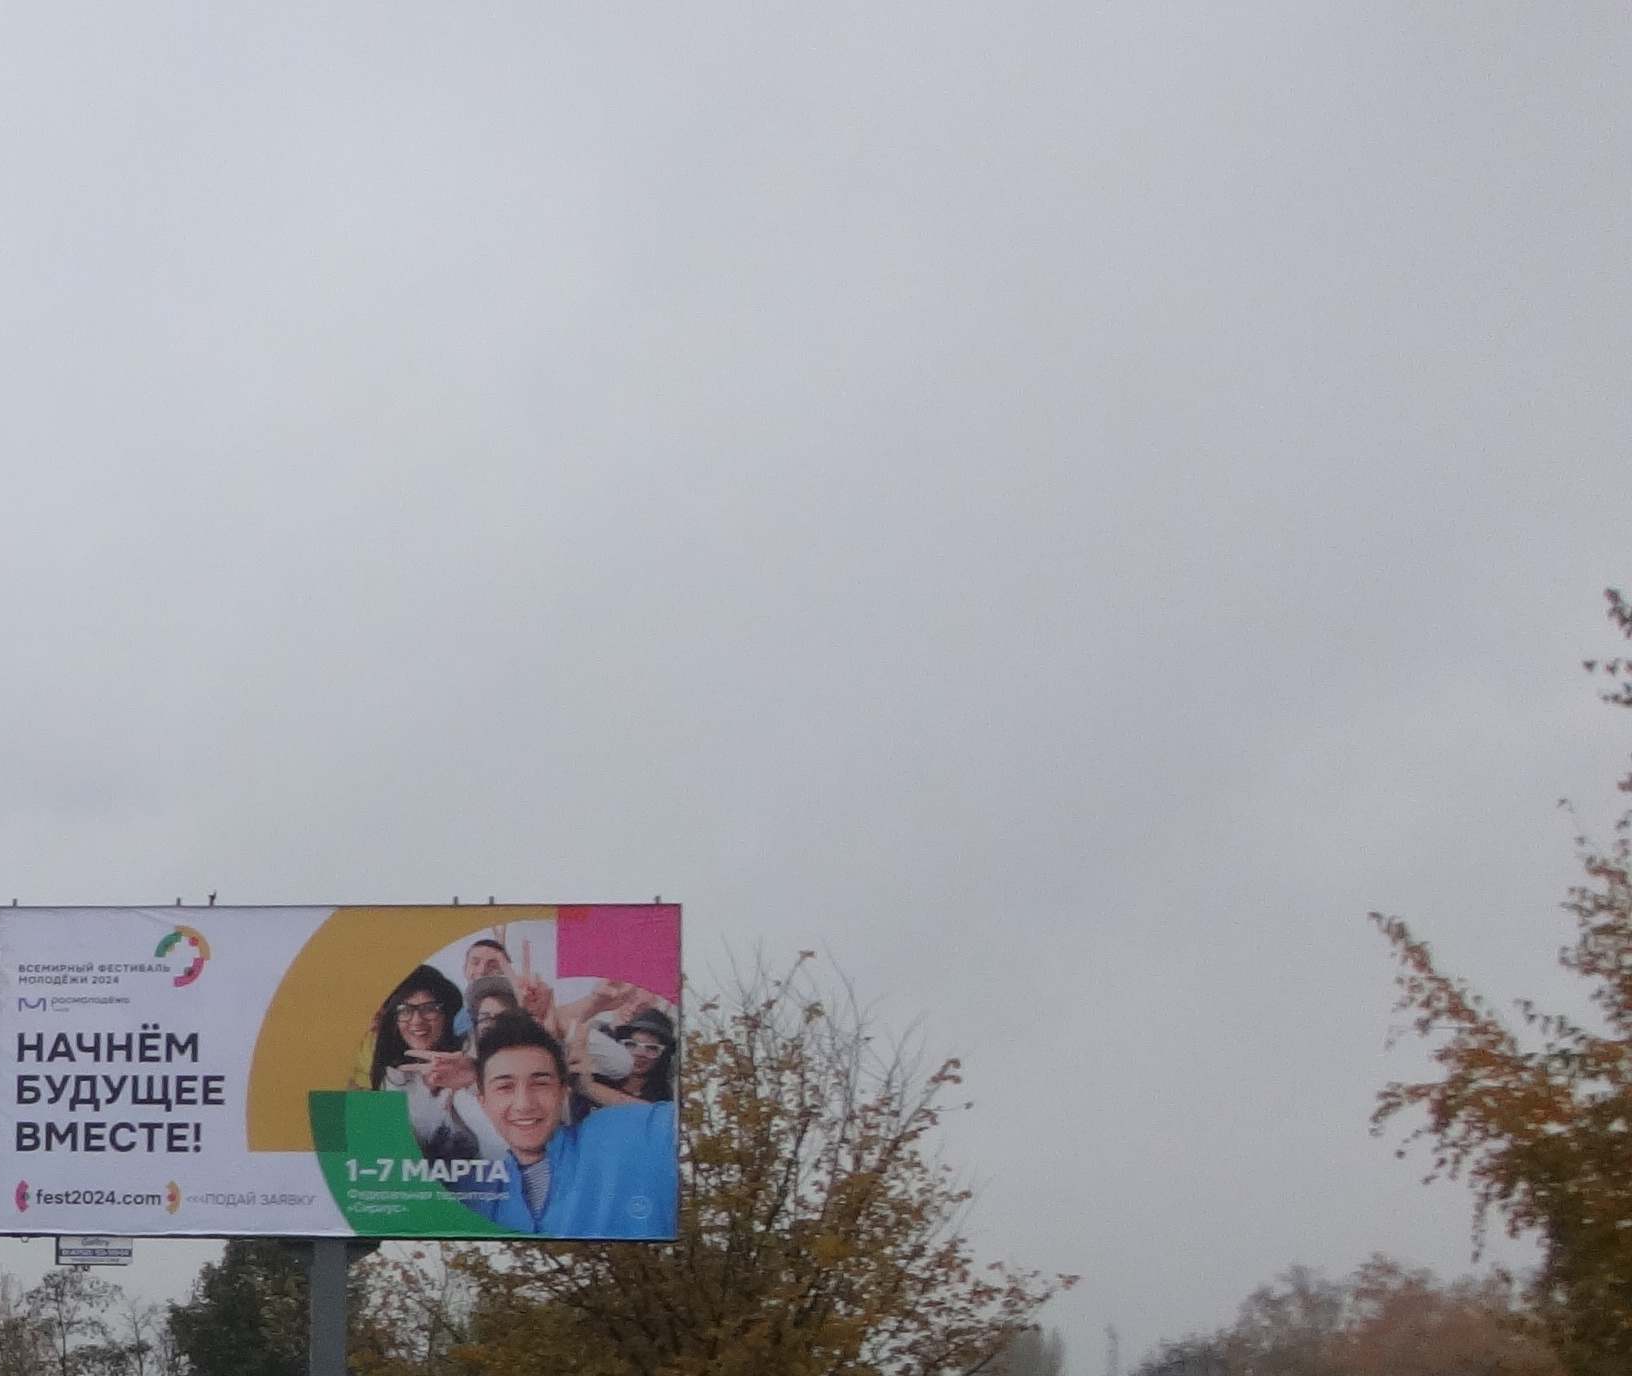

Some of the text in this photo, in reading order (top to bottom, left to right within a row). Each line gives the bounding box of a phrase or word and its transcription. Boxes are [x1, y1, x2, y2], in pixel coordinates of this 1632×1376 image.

[18, 962, 171, 973] ВСЕМИРНЫЙ ФЕСТИВАЛЬ
[18, 974, 120, 985] МОЛОДЁЖИ 2024
[16, 1023, 199, 1063] НАЧНЁМ
[16, 1074, 225, 1112] БУДУЩЕЕ
[15, 1121, 202, 1153] ВМЕСТЕ!
[402, 1158, 511, 1184] МАРТА
[36, 1189, 162, 1206] fest2024.com
